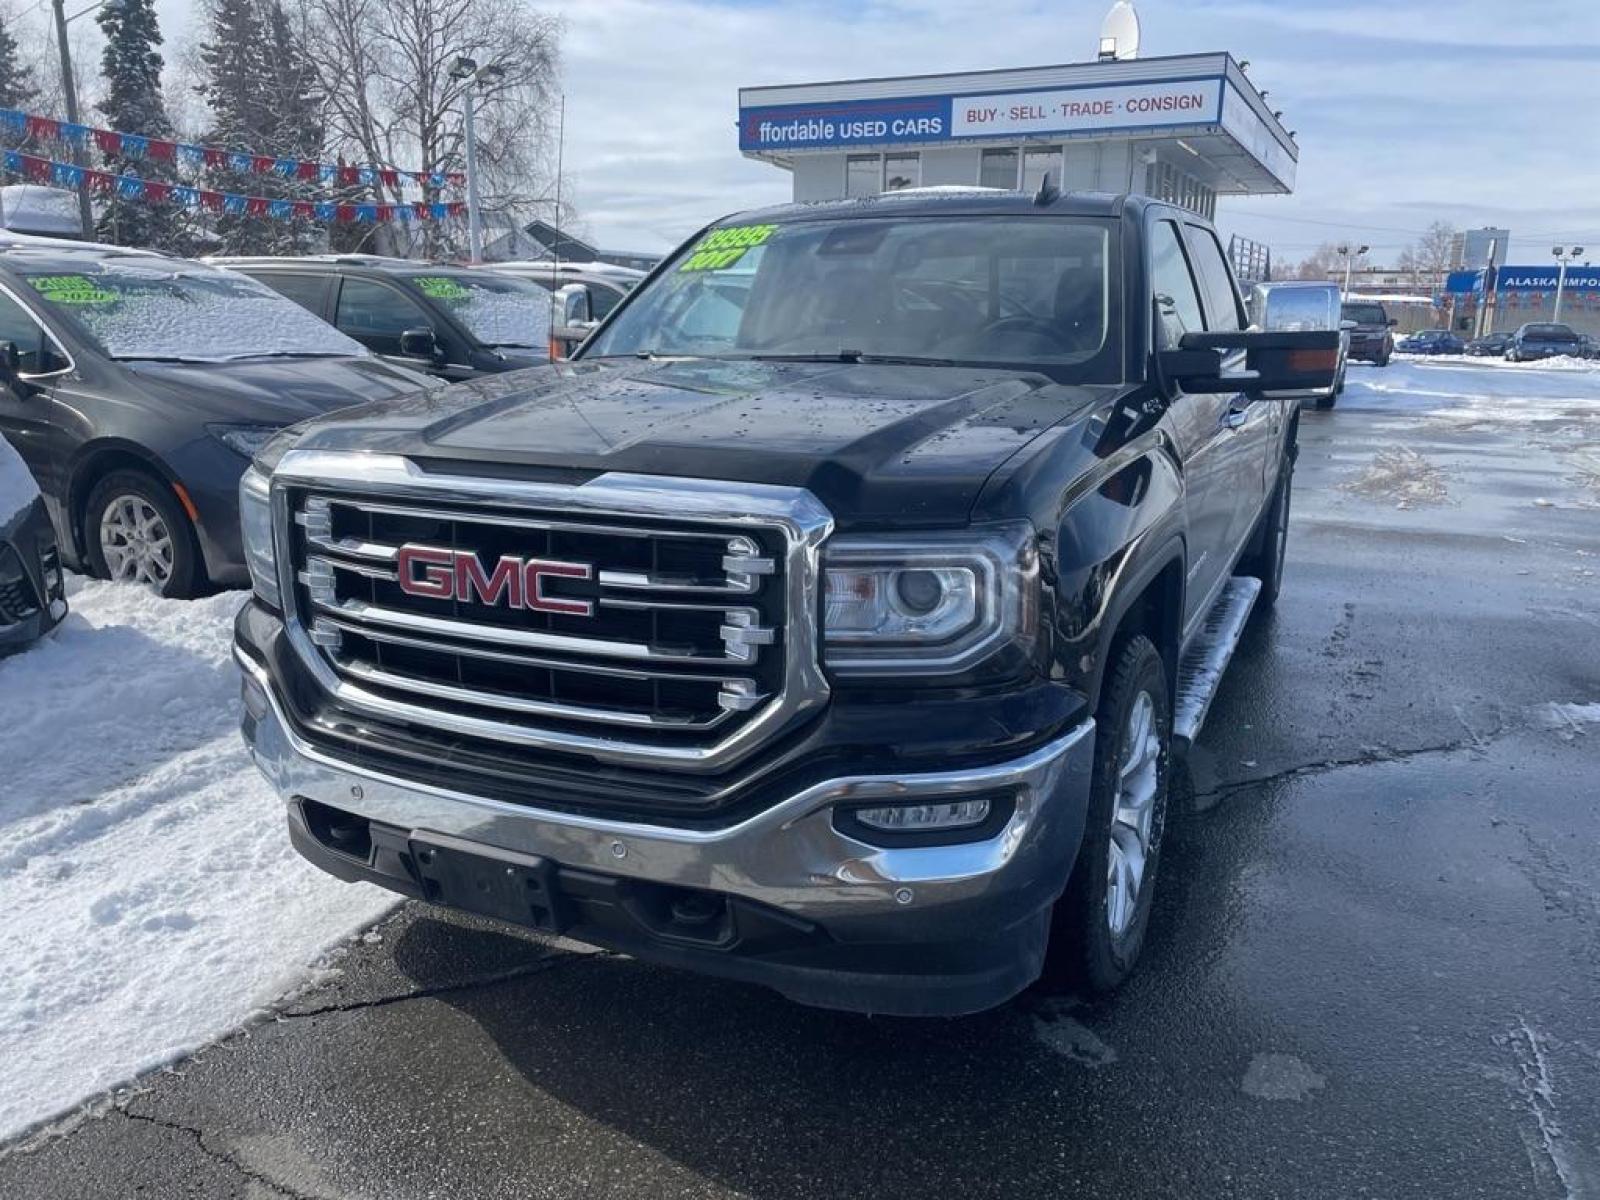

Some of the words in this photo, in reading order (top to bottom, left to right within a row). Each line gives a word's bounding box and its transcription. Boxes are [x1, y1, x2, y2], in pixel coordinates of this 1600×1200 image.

[966, 108, 998, 123] BUY
[1010, 106, 1047, 121] SELL
[1061, 101, 1113, 118] TRADE
[1126, 95, 1204, 113] CONSIGN
[840, 121, 887, 138] USED
[892, 117, 943, 135] CARS
[1505, 277, 1558, 287] ALASKA
[1563, 277, 1600, 287] IMPO
[398, 542, 594, 617] GMC
